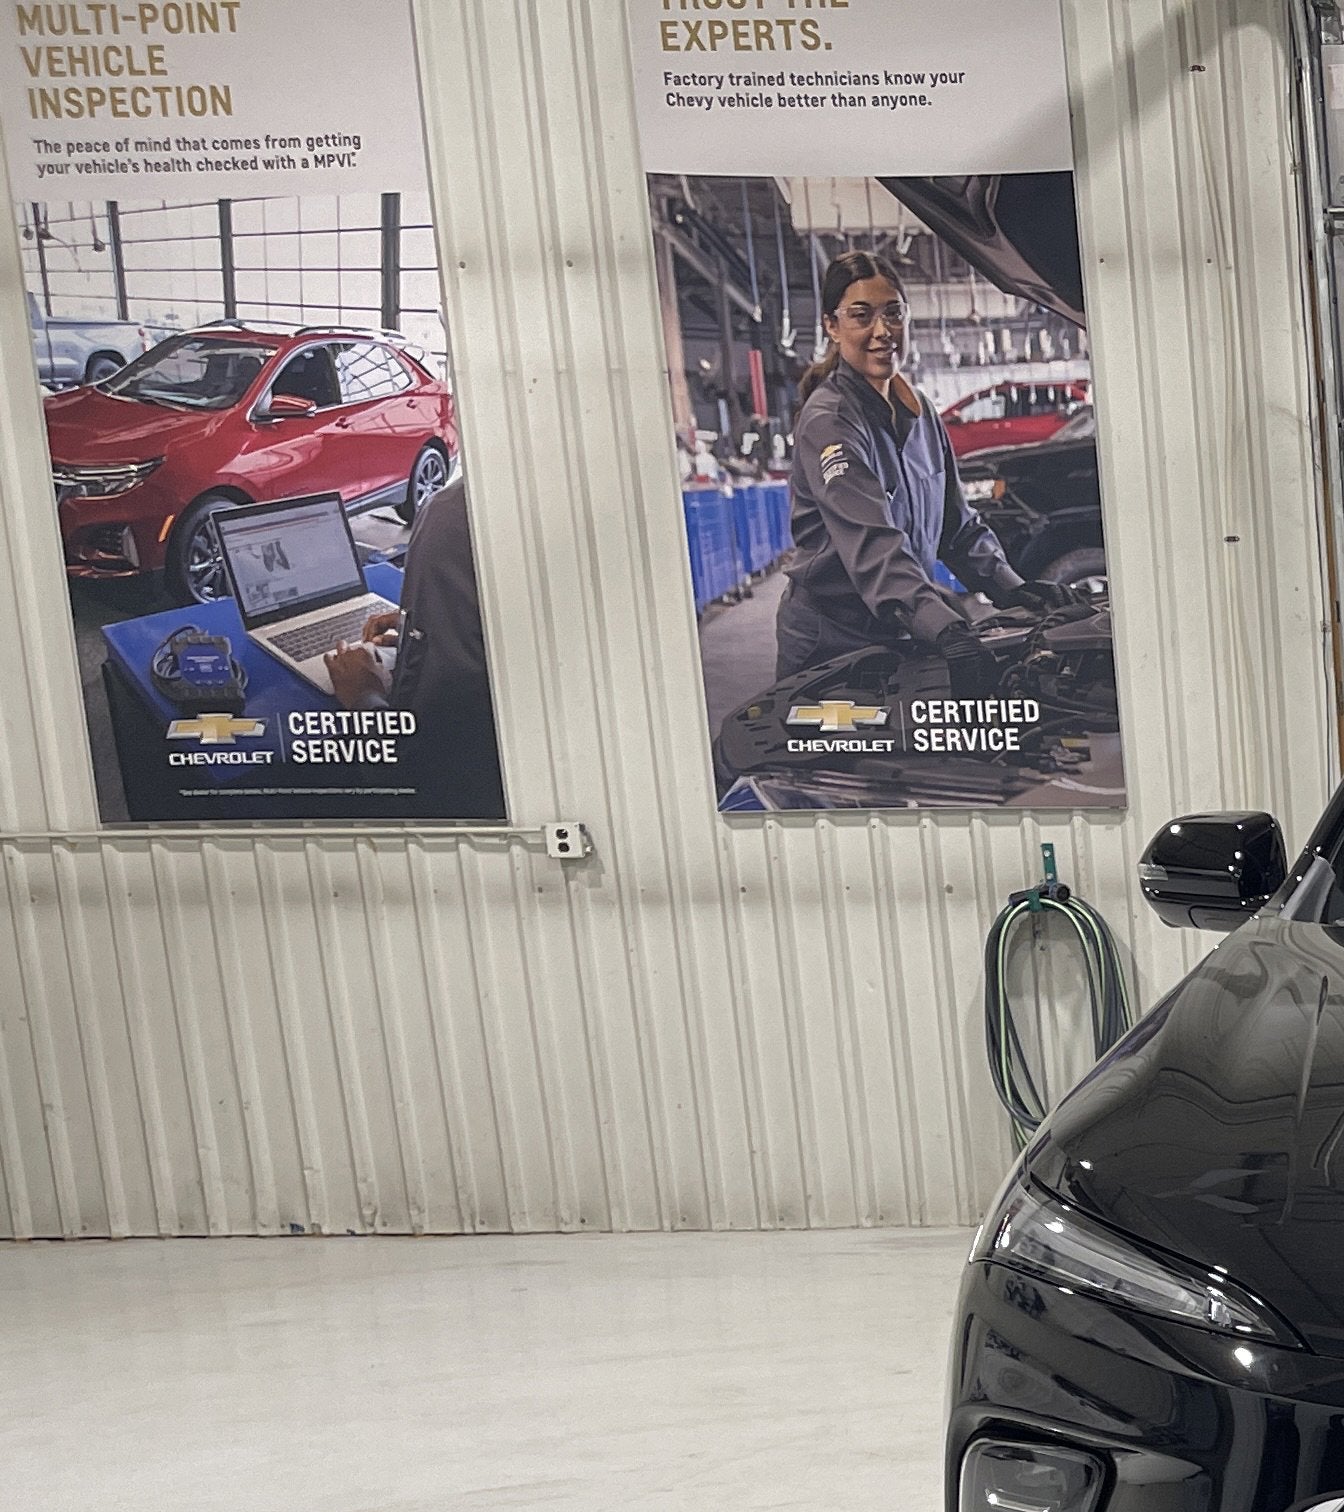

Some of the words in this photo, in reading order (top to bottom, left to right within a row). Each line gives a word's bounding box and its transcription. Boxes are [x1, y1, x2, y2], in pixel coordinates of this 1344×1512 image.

[16, 1, 241, 36] MULTI-POINT
[659, 19, 833, 52] EXPERTS.
[20, 44, 169, 78] VEHICLE
[663, 71, 724, 90] Factory
[728, 71, 785, 87] trained
[789, 70, 879, 86] technicians
[884, 70, 925, 85] know
[930, 71, 966, 88] your
[28, 84, 233, 120] INSPECTION
[665, 92, 714, 110] Chevy
[718, 92, 773, 108] vehicle
[778, 92, 826, 107] better
[831, 91, 867, 107] than
[871, 93, 932, 110] anyone.
[33, 139, 63, 155] The
[66, 141, 110, 158] peace
[115, 138, 131, 153] of
[134, 136, 171, 152] mind
[176, 137, 207, 152] that
[211, 138, 261, 151] comes
[265, 135, 302, 149] from
[306, 132, 362, 153] getting
[37, 162, 71, 179] your
[75, 159, 140, 175] vehicle's
[143, 157, 193, 173] health
[196, 155, 258, 172] checked
[261, 154, 296, 170] with
[300, 158, 310, 169] a
[288, 710, 417, 736] CERTIFIED
[910, 698, 1040, 725] CERTIFIED
[168, 750, 275, 767] CHEVROLET
[292, 739, 399, 764] SERVICE
[787, 738, 895, 753] CHEVROLET
[913, 727, 1020, 752] SERVICE
